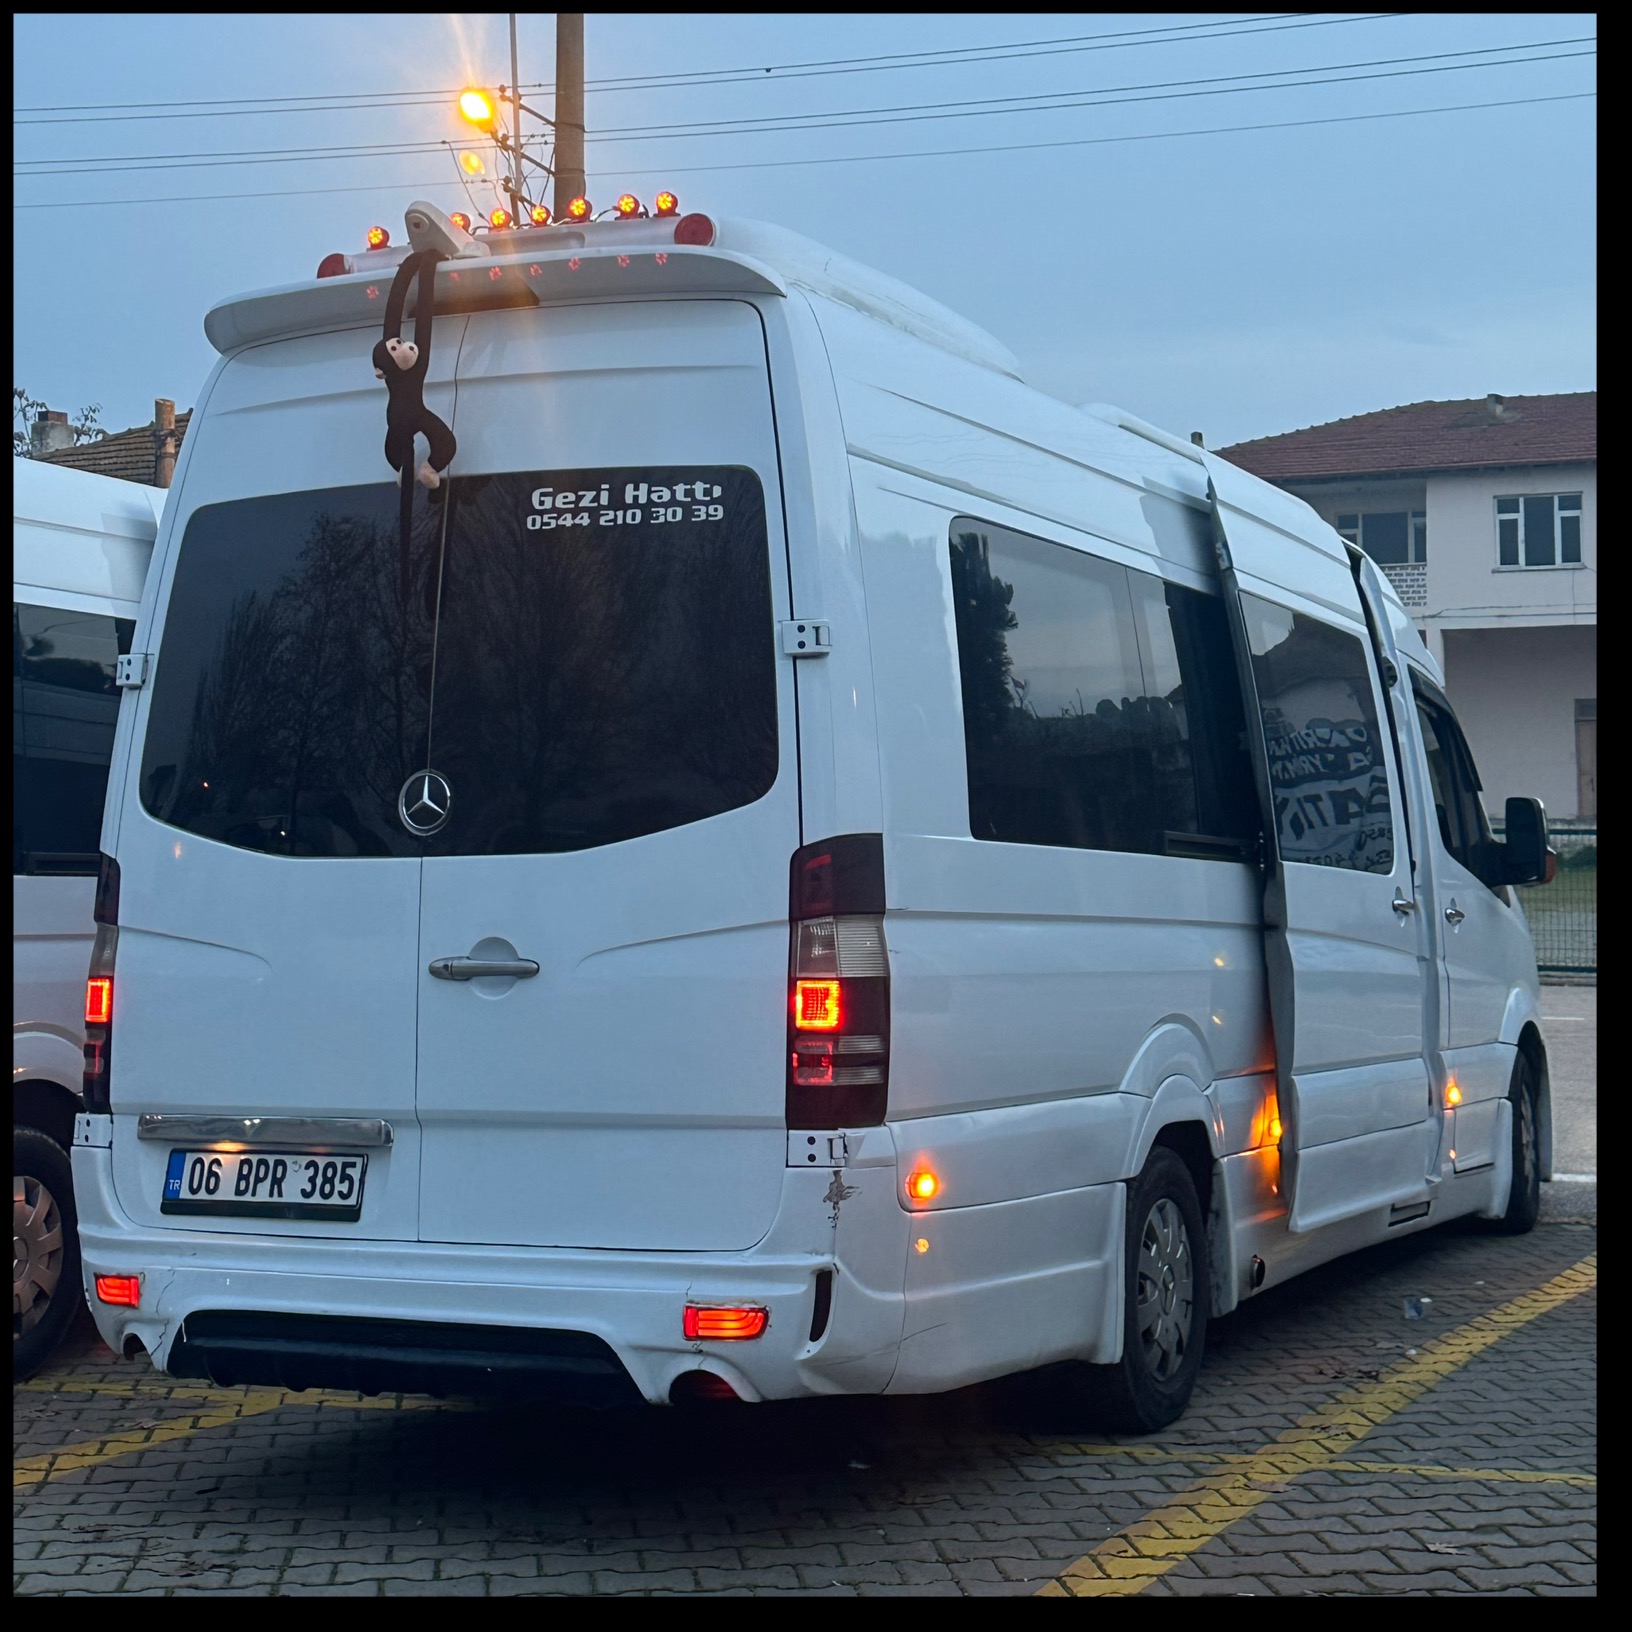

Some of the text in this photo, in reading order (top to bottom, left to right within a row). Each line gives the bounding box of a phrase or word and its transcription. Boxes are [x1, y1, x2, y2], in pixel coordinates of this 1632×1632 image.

[531, 483, 610, 510] Gezi
[526, 504, 724, 530] 0544 210 30 39
[169, 1157, 357, 1201] TR 06 BPR 385
